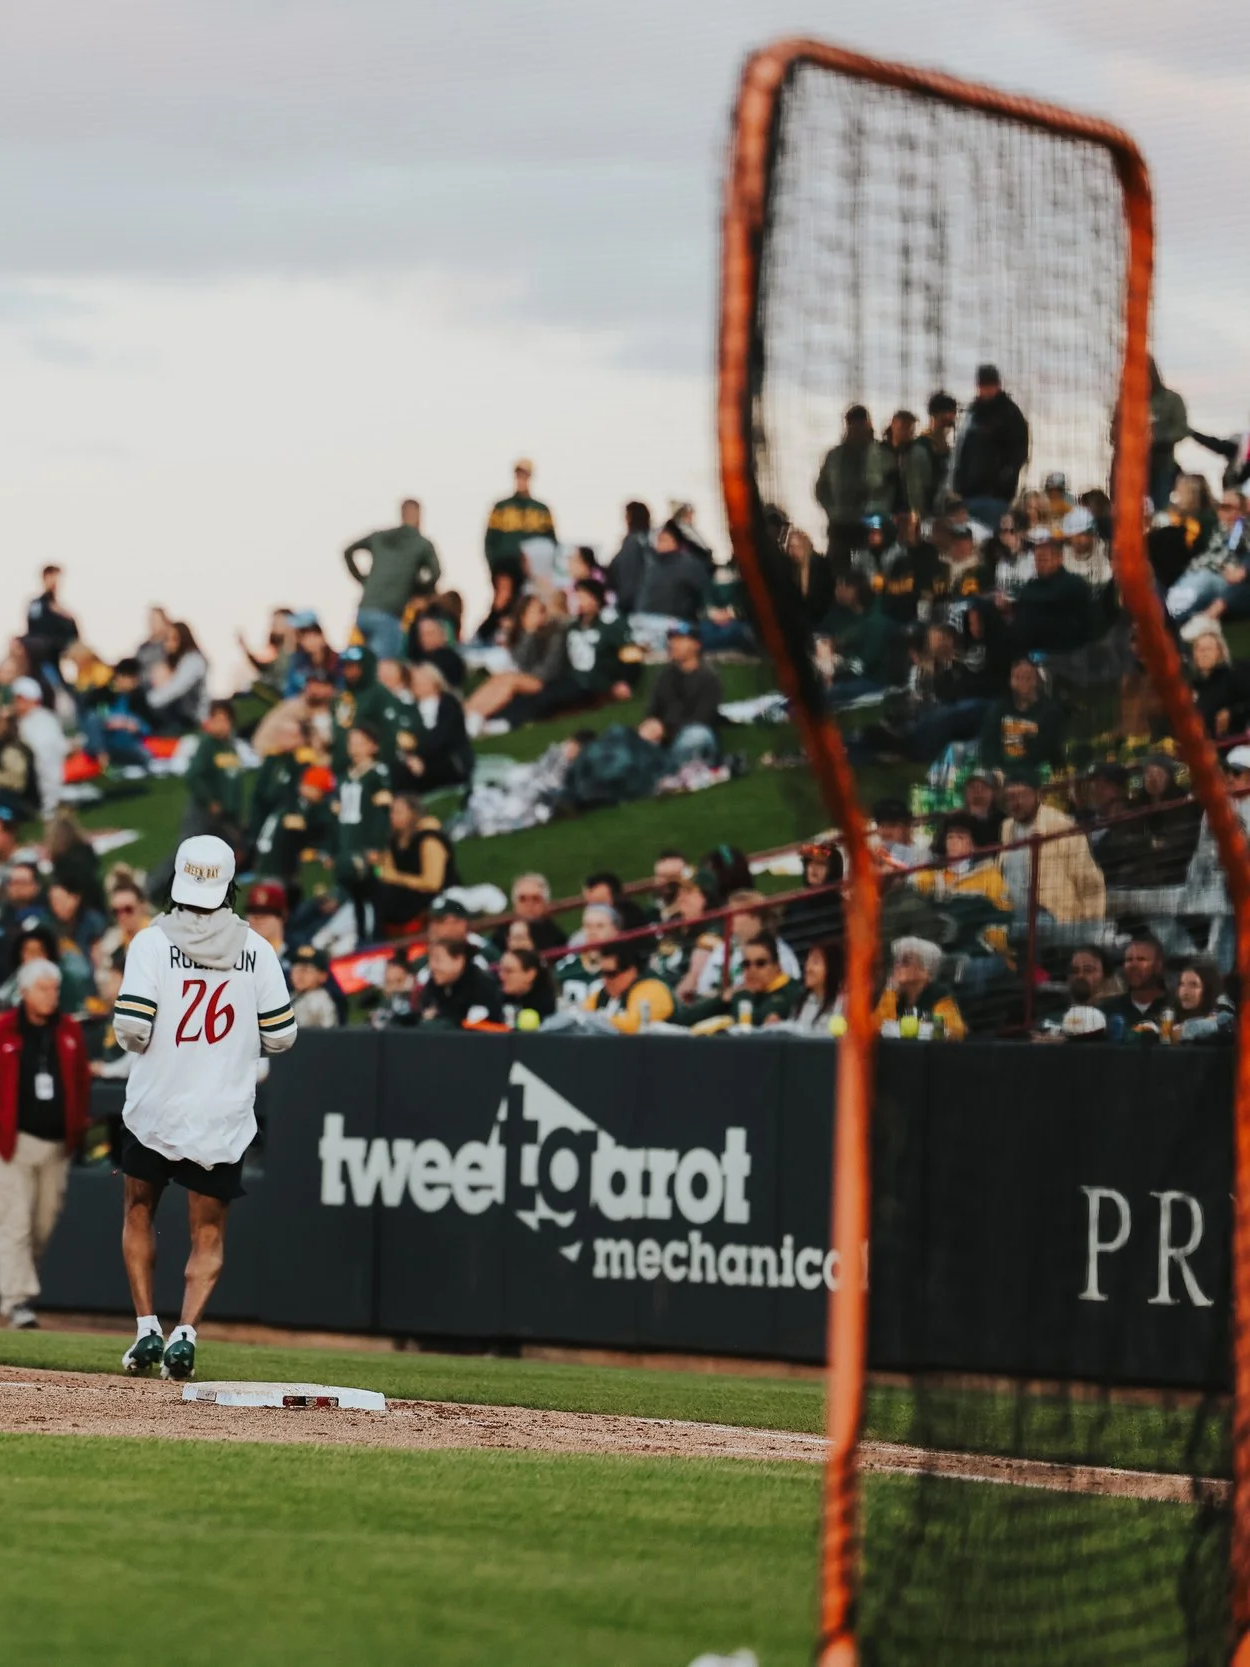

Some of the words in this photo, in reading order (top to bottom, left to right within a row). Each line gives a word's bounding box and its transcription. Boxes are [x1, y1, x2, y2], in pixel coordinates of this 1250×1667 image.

[170, 945, 257, 973] ROON
[175, 979, 235, 1048] 26
[592, 1230, 868, 1291] mechanic
